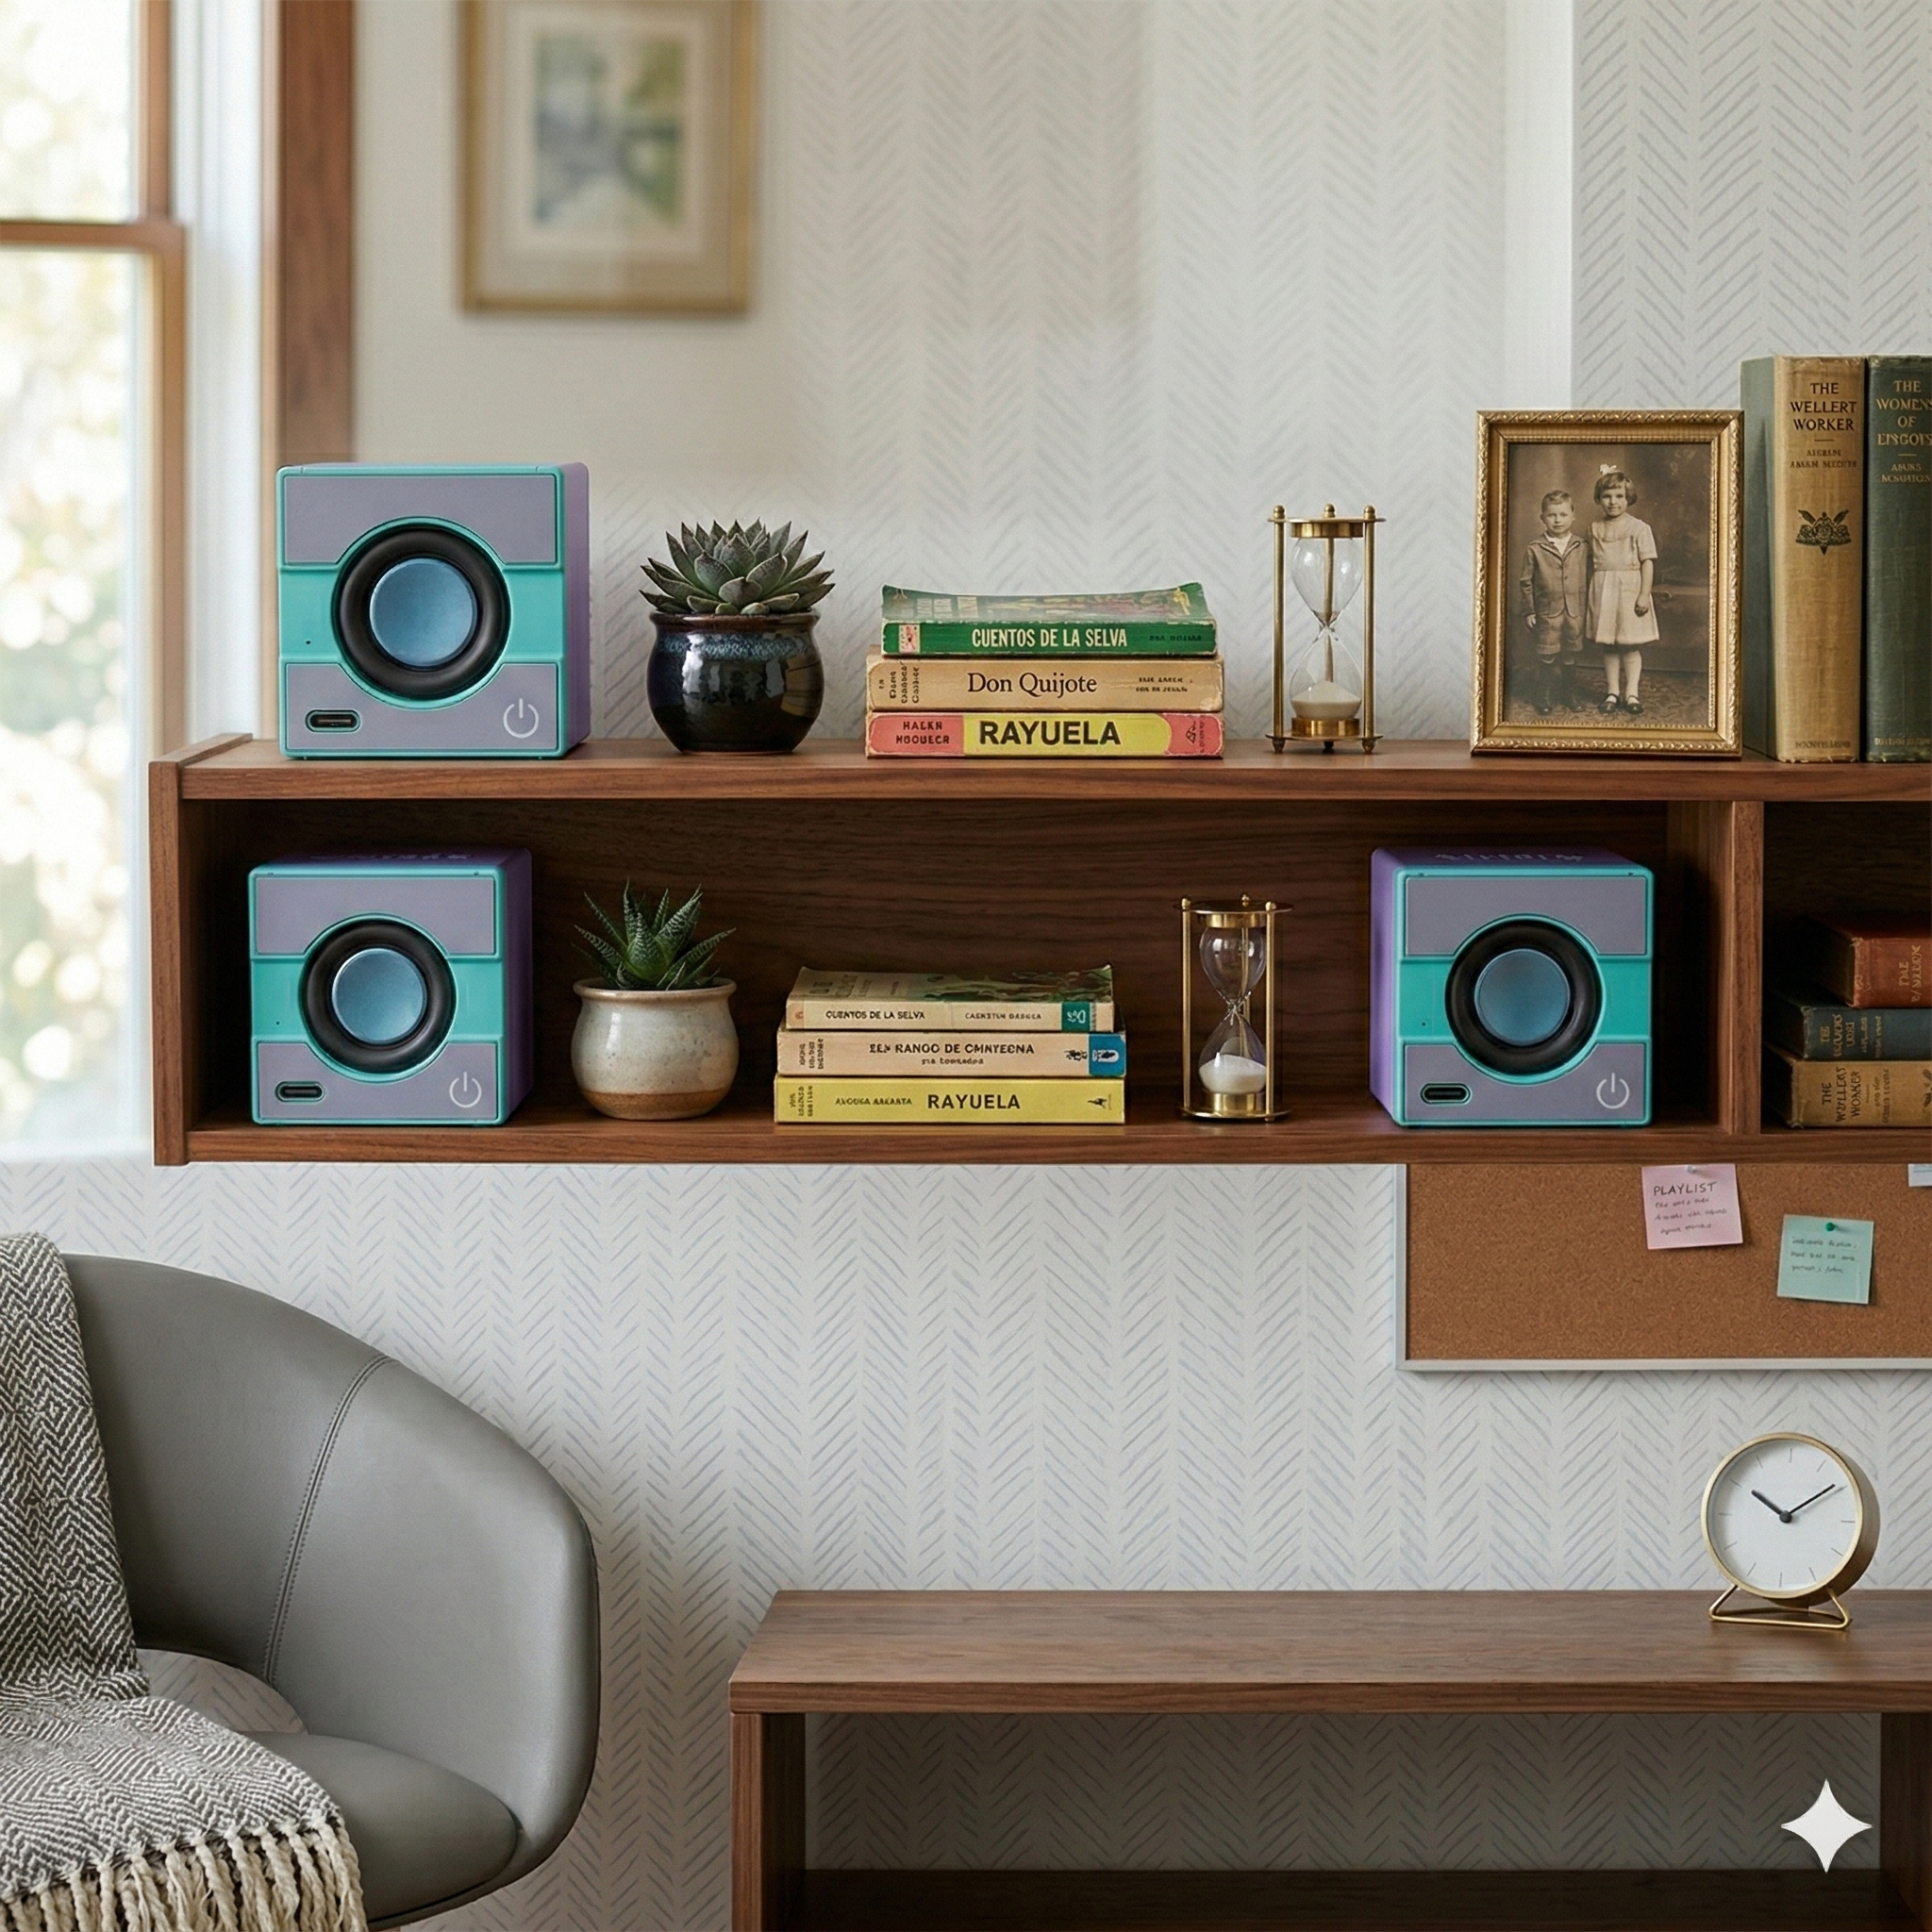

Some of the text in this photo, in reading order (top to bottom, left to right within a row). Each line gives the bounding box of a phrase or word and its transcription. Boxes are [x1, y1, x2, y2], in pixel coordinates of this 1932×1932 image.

[1810, 383, 1839, 394] THE
[1893, 380, 1922, 392] THE
[1790, 401, 1857, 413] WELLERT
[1793, 419, 1855, 431] WORKER
[1897, 415, 1917, 428] OF
[972, 628, 1127, 647] CUENTOS DE LA SELVA
[967, 672, 1097, 698] Don Quijote
[979, 721, 1121, 745] RAYUELA
[944, 1043, 960, 1054] DE
[1822, 1082, 1832, 1105] THE
[927, 1094, 1021, 1109] RAYUELA
[1653, 1181, 1717, 1196] PLAYLIST
